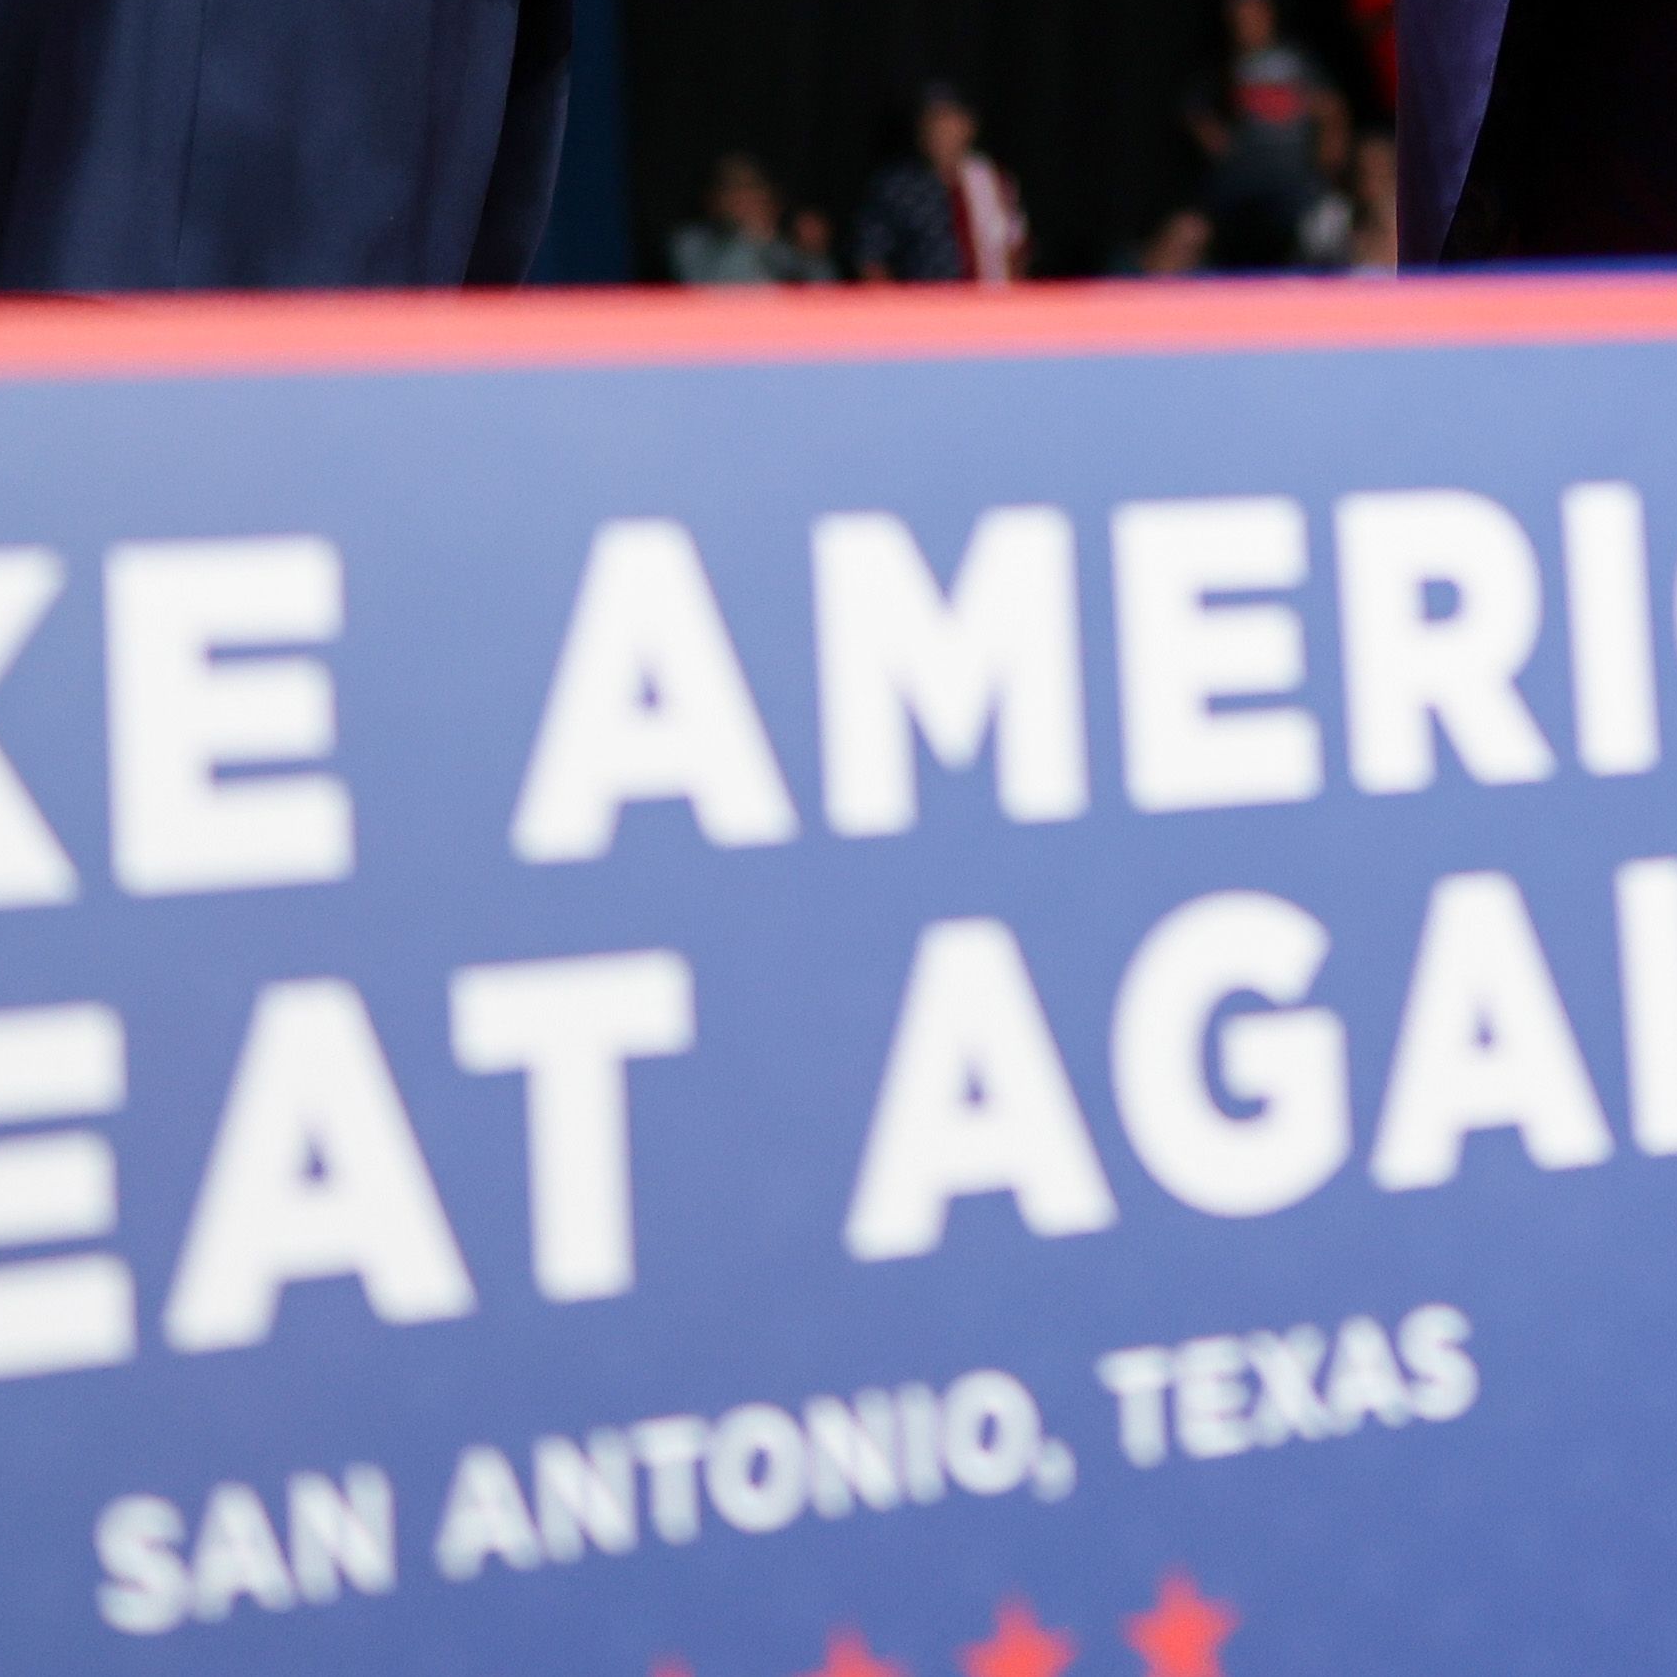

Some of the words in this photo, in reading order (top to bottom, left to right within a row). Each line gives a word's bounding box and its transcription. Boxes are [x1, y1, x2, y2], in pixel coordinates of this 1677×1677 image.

[97, 1464, 392, 1632] SAN
[438, 1370, 1074, 1575] ANTONIO,
[1100, 1304, 1476, 1463] TEXAS
